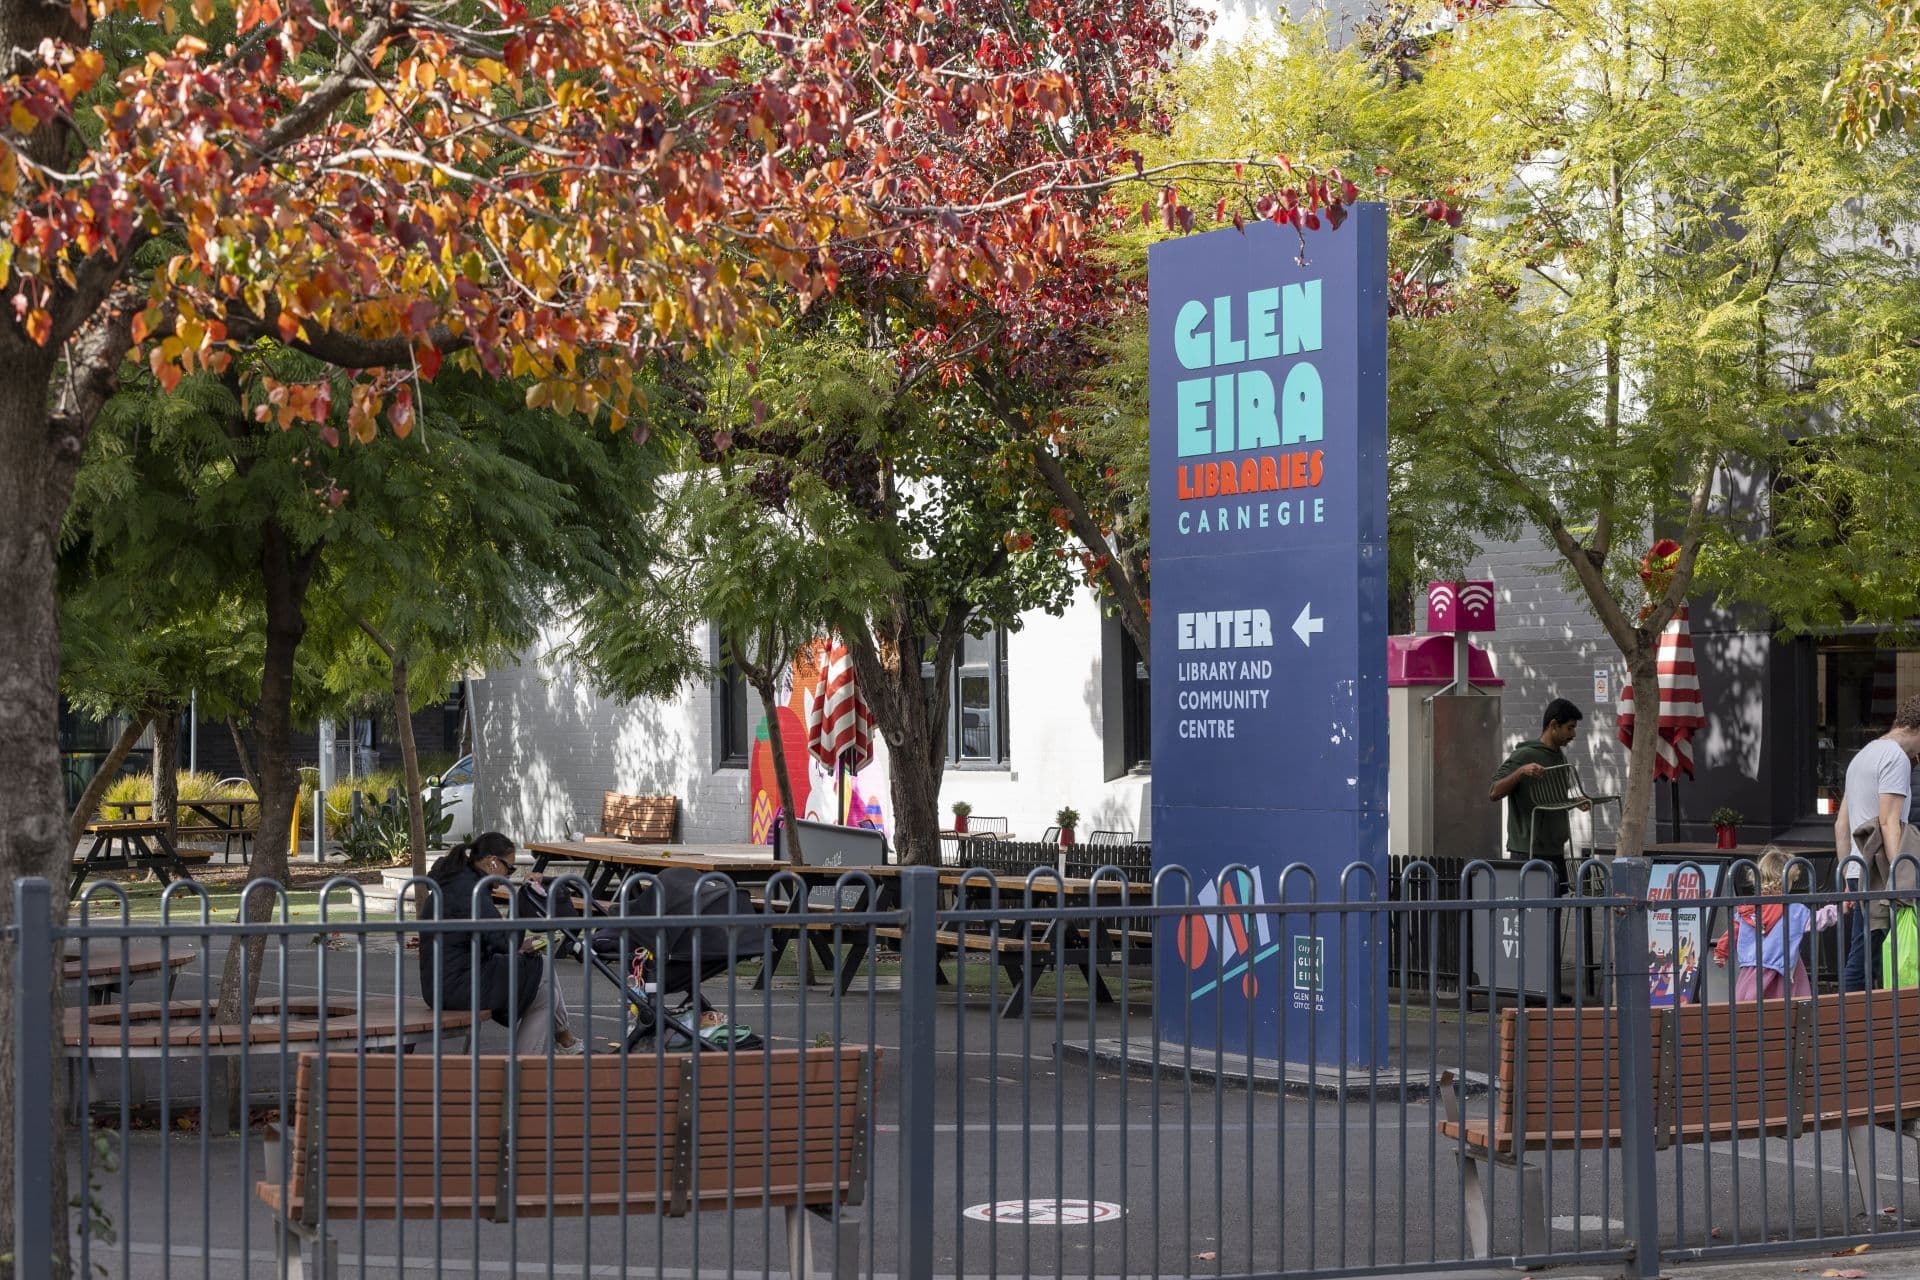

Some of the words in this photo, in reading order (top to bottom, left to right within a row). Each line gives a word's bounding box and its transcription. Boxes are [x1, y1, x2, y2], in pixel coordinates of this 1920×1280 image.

[1174, 278, 1322, 370] GLEN
[1177, 361, 1323, 458] EIRA
[1178, 449, 1324, 500] LIBRARIES
[1178, 498, 1324, 535] CARNEGIE
[1178, 609, 1273, 650] ENTER
[1178, 661, 1237, 682] LIBRARY
[1240, 660, 1272, 680] AND
[1178, 689, 1270, 710] COMMUNITY
[1178, 719, 1235, 739] CENTRE
